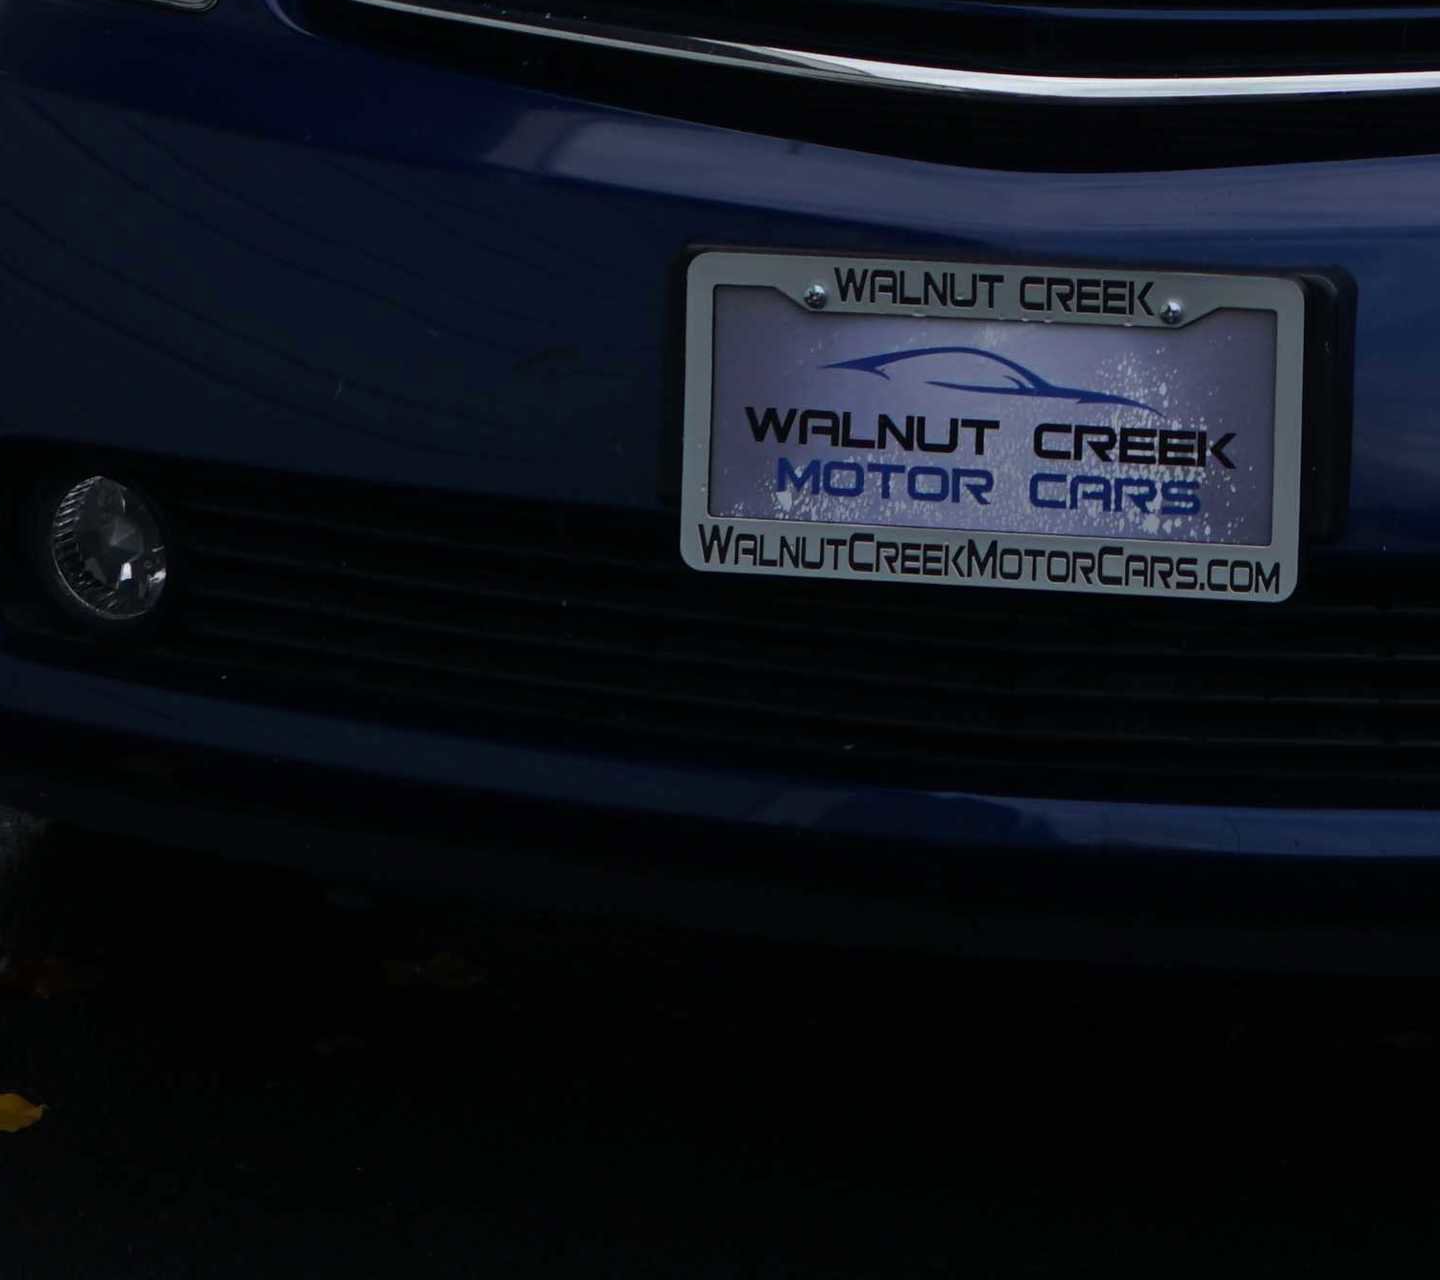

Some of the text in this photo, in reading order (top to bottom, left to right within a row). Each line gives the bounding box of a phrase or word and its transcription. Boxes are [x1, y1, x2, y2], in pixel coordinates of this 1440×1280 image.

[834, 267, 1154, 317] WALNUT CREEK
[745, 406, 1237, 469] WALNUT CREEK
[776, 457, 1201, 515] MOTOR CARS
